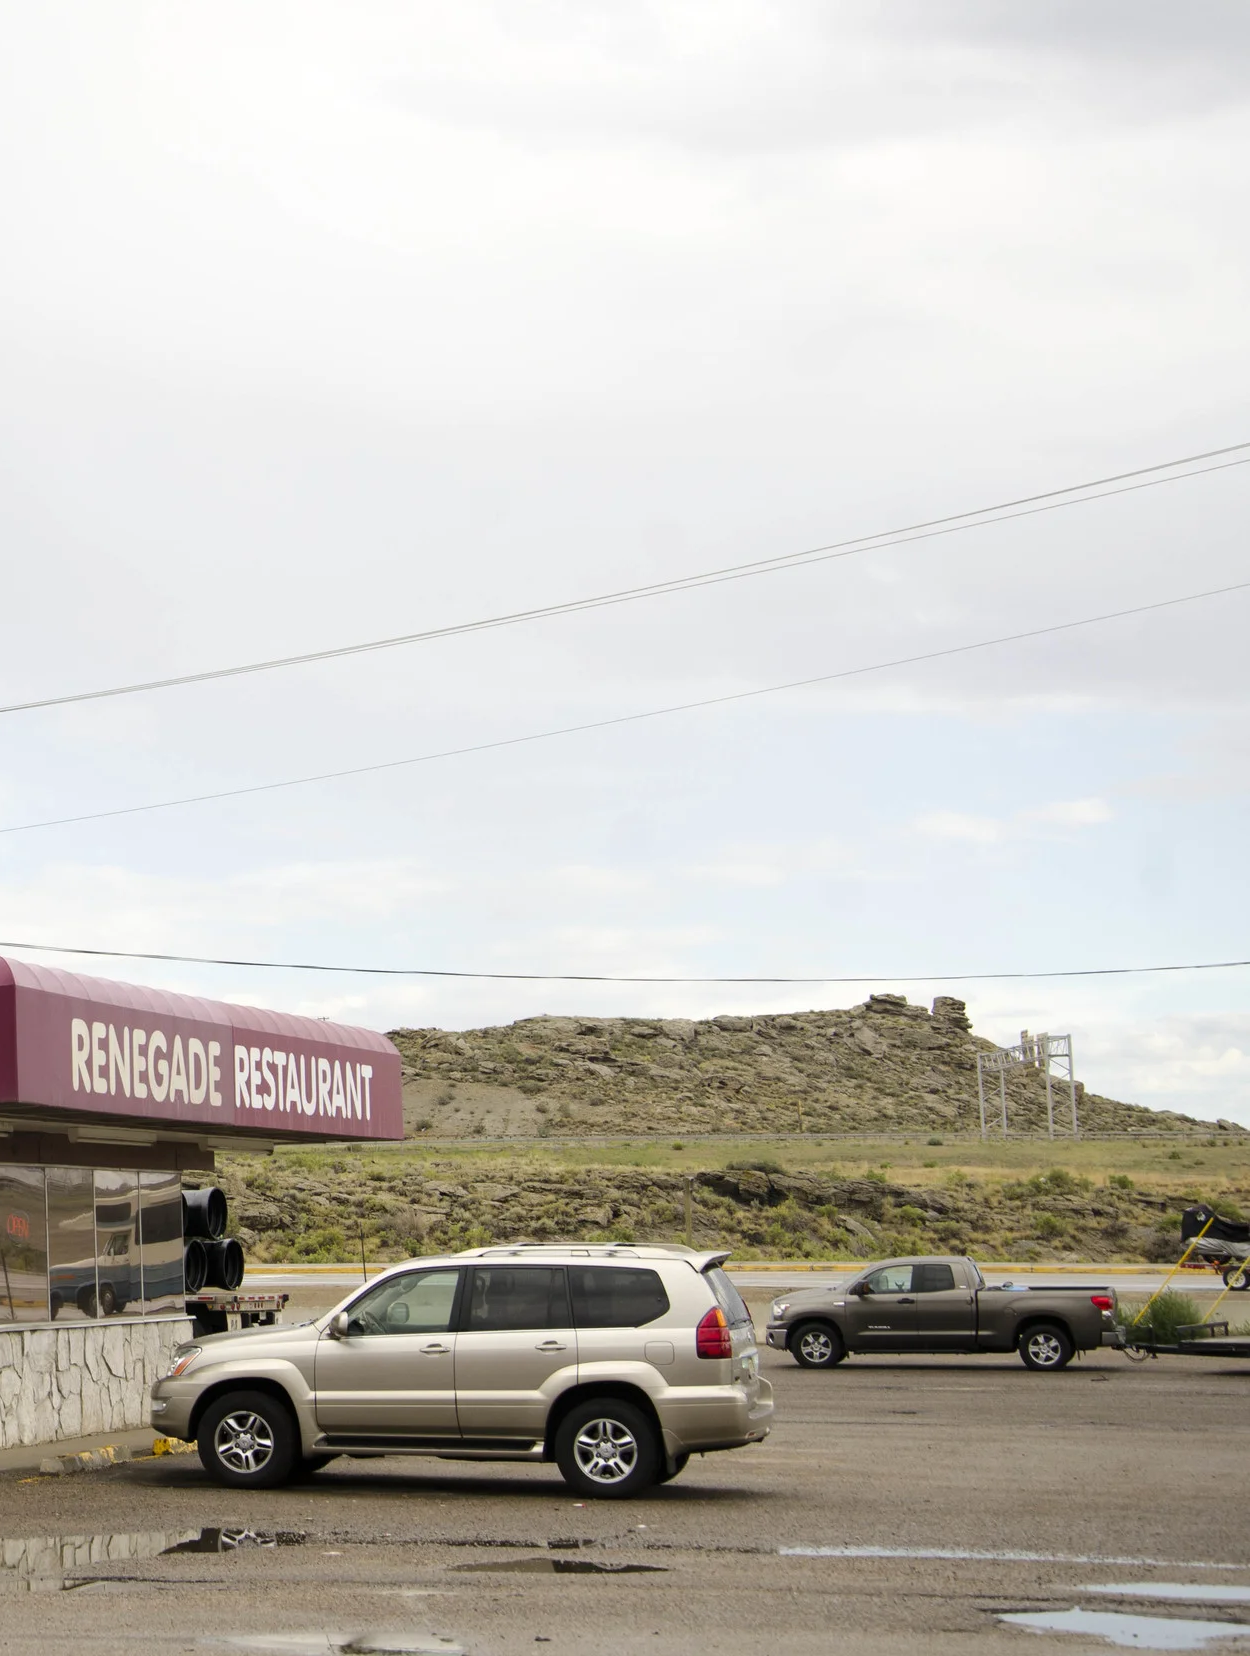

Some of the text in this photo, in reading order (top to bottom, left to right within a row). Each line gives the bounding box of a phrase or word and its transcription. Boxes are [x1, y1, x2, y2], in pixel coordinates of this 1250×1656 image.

[71, 1017, 374, 1121] RENEGADE RESTAURANT
[7, 1213, 29, 1239] OPEN
